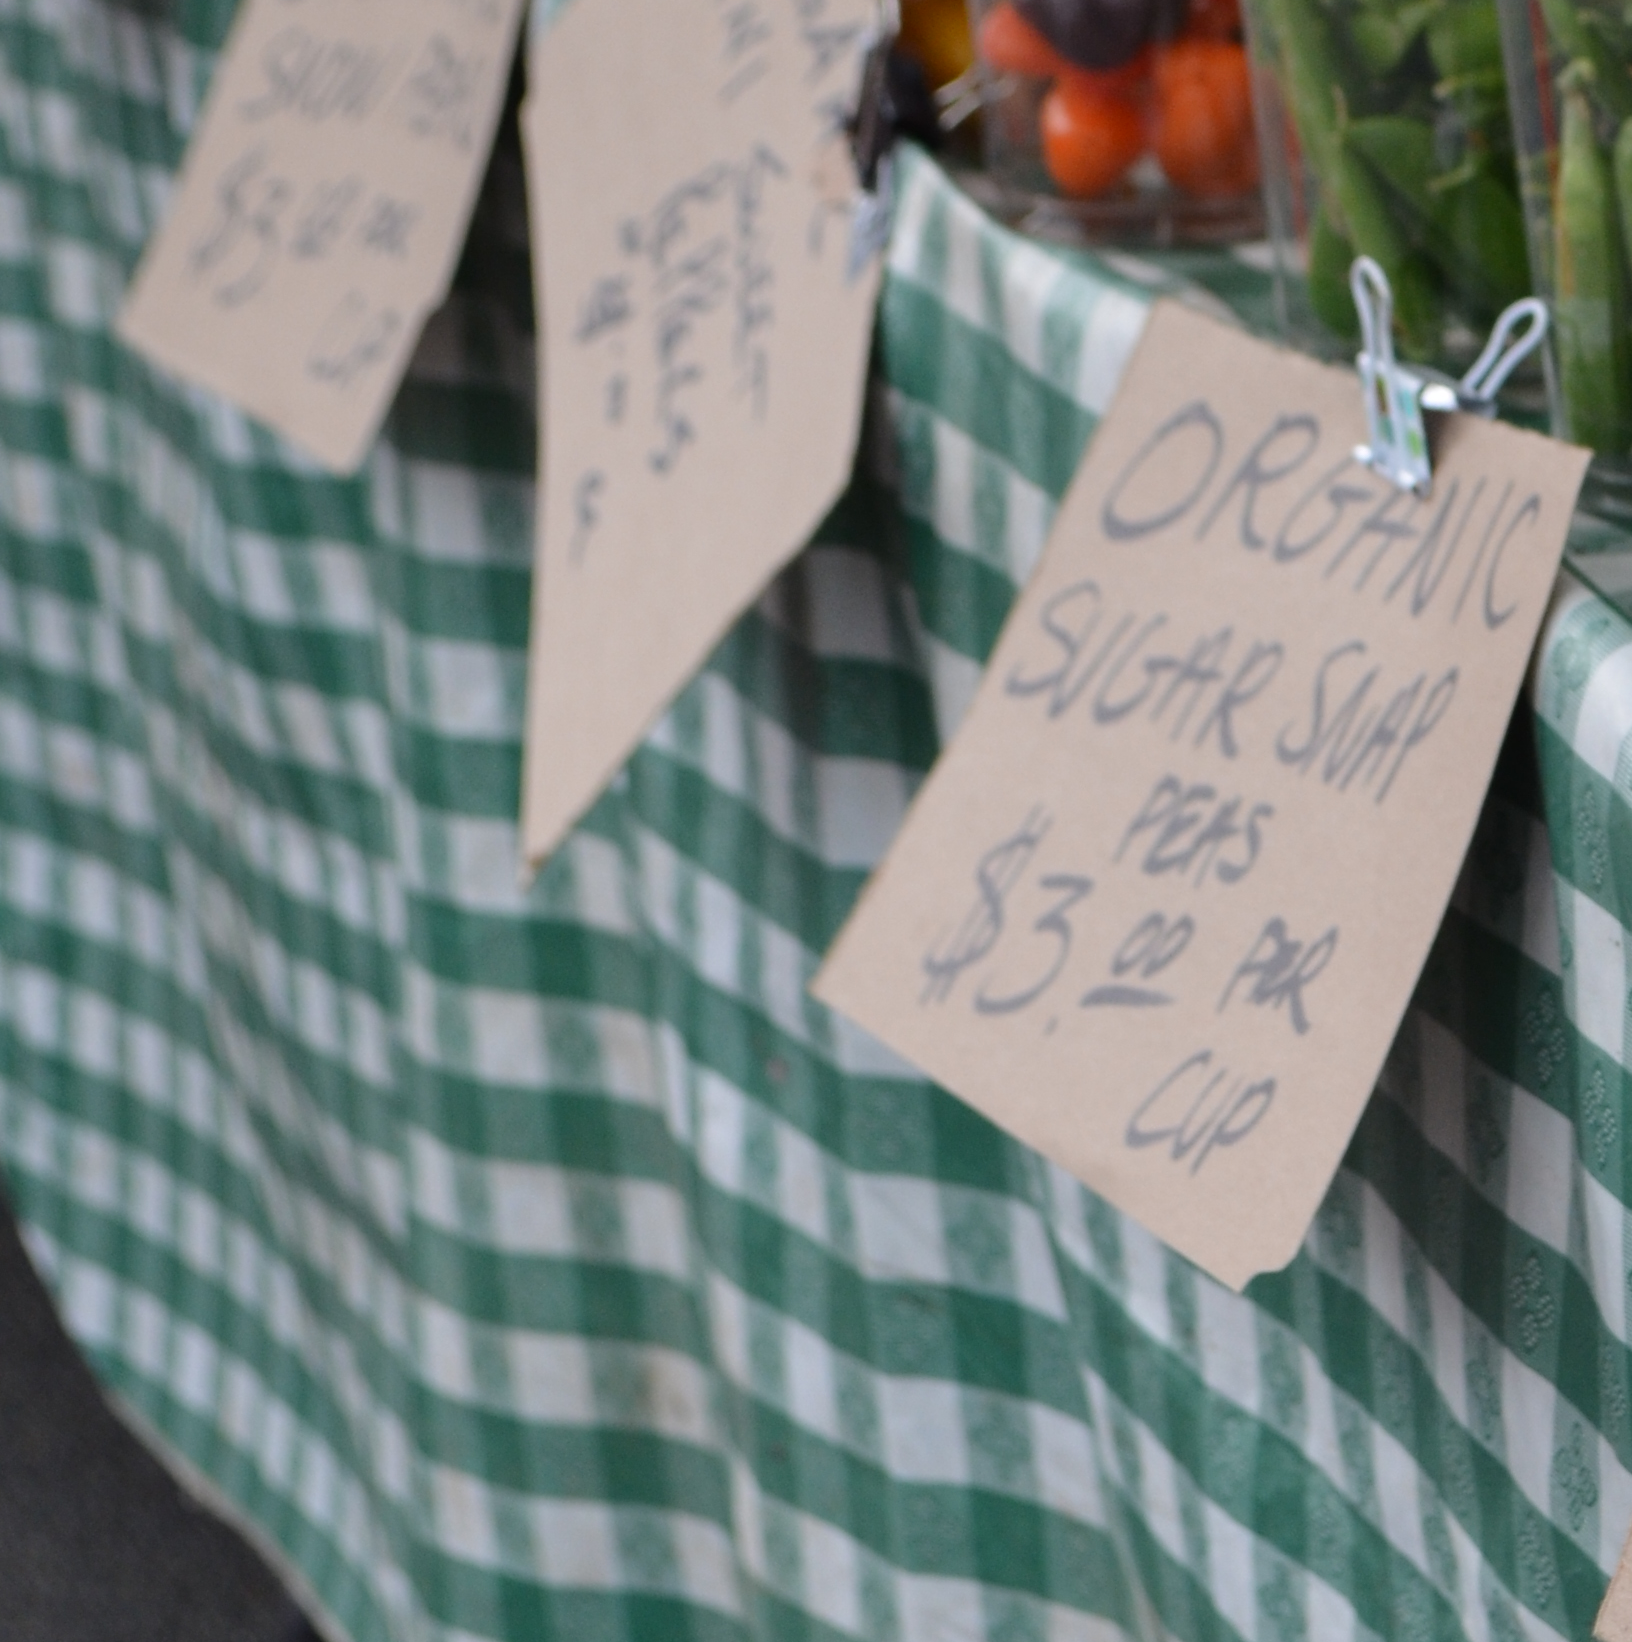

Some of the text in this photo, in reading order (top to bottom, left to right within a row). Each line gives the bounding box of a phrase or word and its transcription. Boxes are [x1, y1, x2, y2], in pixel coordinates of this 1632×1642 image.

[1102, 403, 1541, 630] ORGANIC
[1008, 581, 1460, 805] SUGAR SNAP
[1114, 775, 1275, 885] PEAS
[1217, 917, 1339, 1036] PER
[1125, 1050, 1277, 1174] CUP
